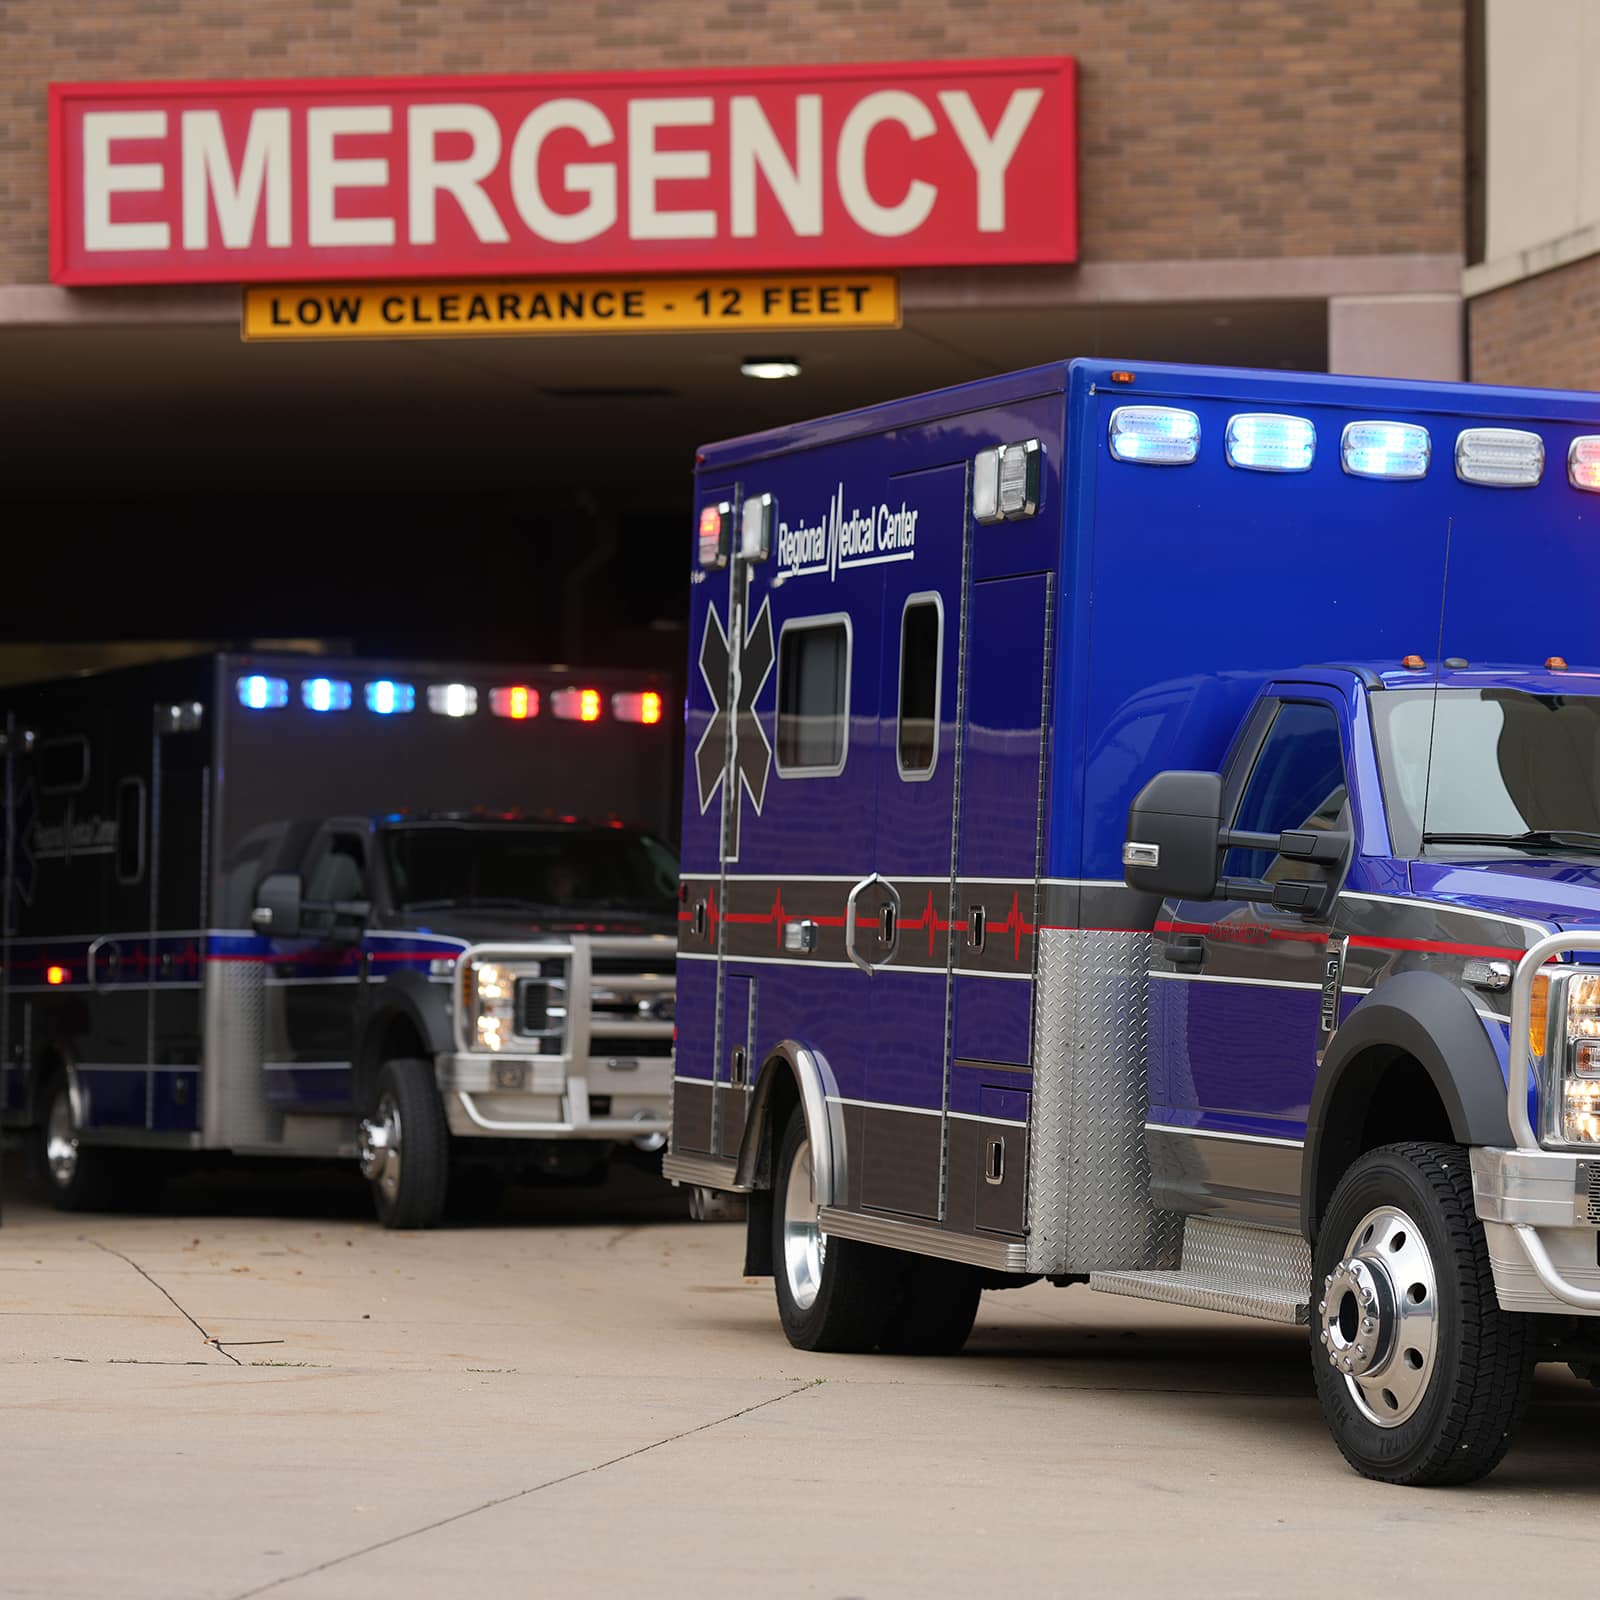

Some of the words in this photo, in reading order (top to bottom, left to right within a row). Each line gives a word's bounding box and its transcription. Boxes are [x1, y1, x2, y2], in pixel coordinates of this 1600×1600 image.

[83, 88, 1044, 252] EMERGENCY
[271, 296, 364, 327] LOW
[382, 289, 646, 325] CLEARANCE
[696, 288, 743, 317] 12
[763, 283, 873, 316] FEET
[777, 514, 827, 576] Regional
[826, 481, 876, 582] Medical
[877, 501, 919, 551] Center
